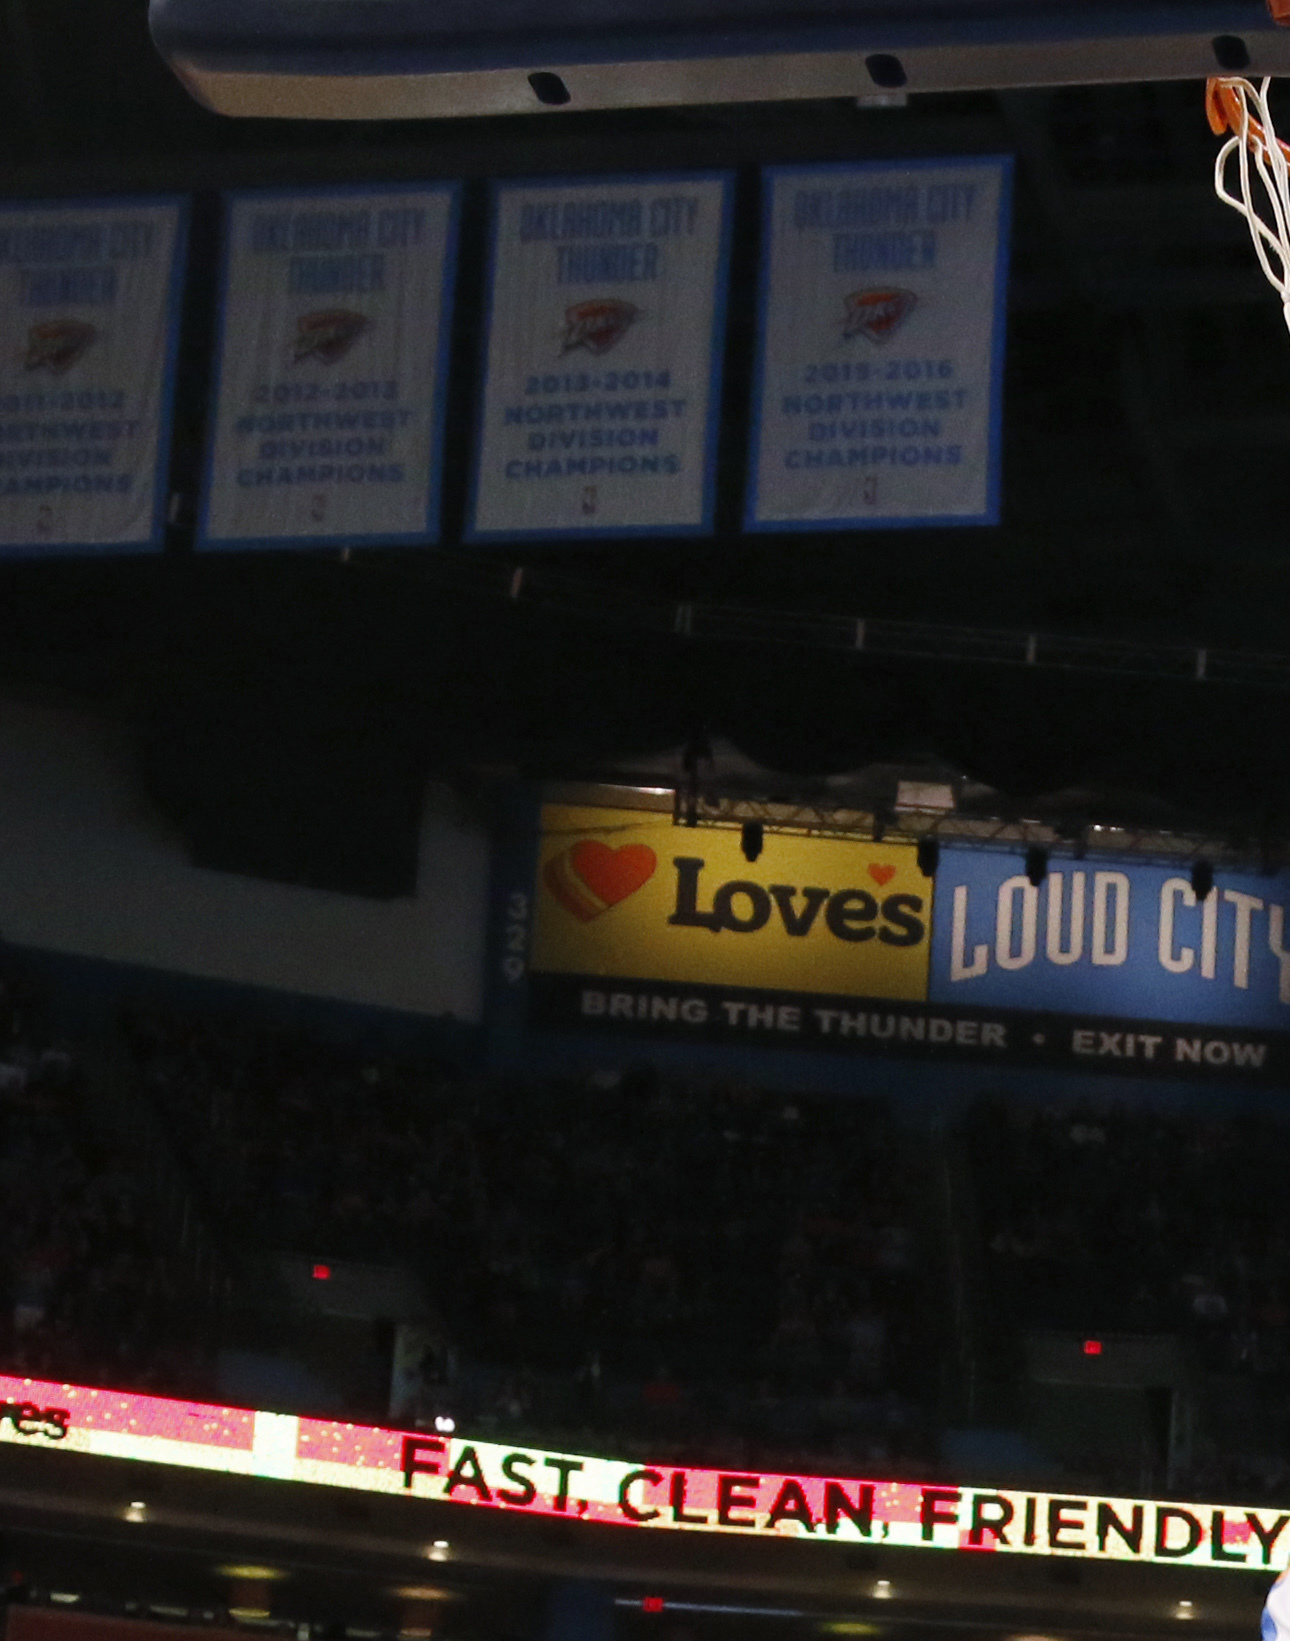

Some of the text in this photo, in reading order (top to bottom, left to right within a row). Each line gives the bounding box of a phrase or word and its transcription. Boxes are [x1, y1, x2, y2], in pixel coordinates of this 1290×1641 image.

[504, 399, 688, 427] NORTHWEST
[782, 388, 968, 414] NORTHWEST
[234, 409, 411, 435] NORTHWEST
[808, 417, 941, 441] DIVISION
[259, 437, 387, 460] DIVISION
[528, 427, 659, 452] DIVISION
[505, 453, 681, 480] CHAMPIONS
[784, 445, 963, 470] CHAMPIONS
[236, 463, 404, 488] CHAMPIONS
[950, 871, 1129, 983] LOUD
[581, 990, 1267, 1069] BRING THE THUNDER EXIT NOW
[401, 1436, 589, 1516] FAST,
